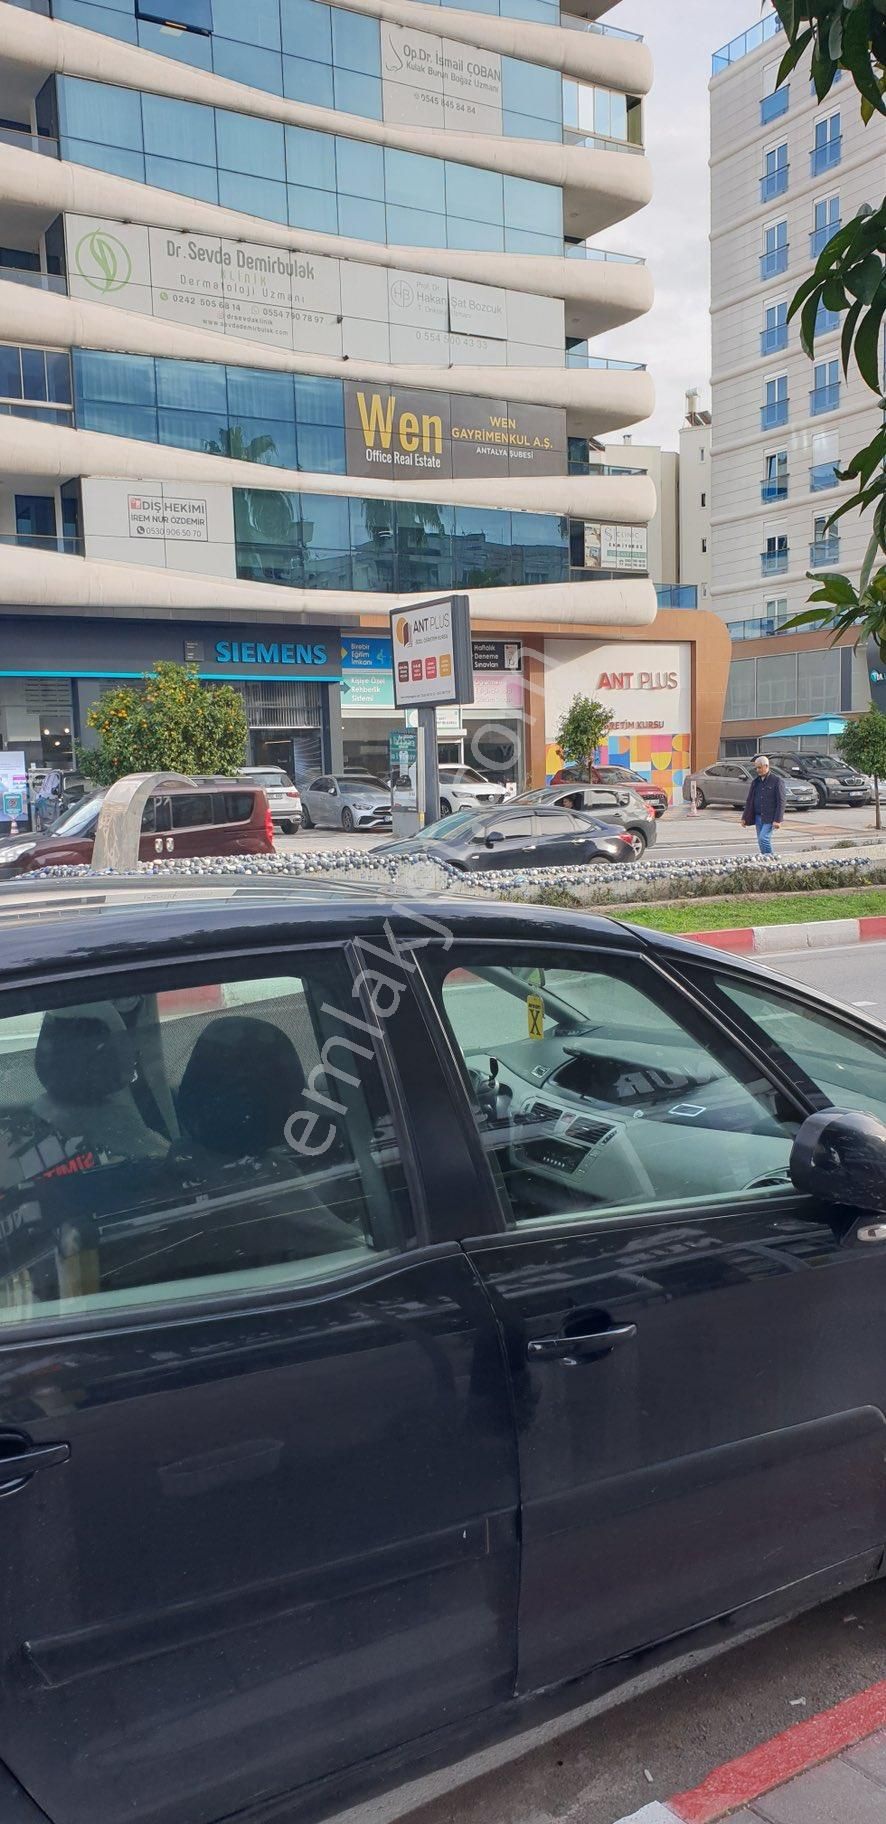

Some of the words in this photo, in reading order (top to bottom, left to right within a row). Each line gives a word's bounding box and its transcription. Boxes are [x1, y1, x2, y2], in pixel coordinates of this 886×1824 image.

[406, 61, 425, 73] Kulak
[428, 66, 448, 79] Burun
[451, 72, 472, 86] Boğaz
[436, 50, 464, 72] İsmail
[467, 62, 501, 82] ÇOBAN
[420, 93, 439, 105] 0545
[166, 239, 186, 259] Dr.
[188, 241, 231, 266] Sevda
[236, 249, 315, 280] Demirbulak
[180, 274, 255, 297] Dermatoloji
[263, 289, 305, 304] Uzmanı
[172, 294, 196, 305] 0242
[201, 299, 217, 308] 505
[232, 303, 241, 311] 14
[416, 291, 448, 306] Hakan
[469, 299, 503, 315] Bozcuk
[263, 307, 283, 318] 0554
[303, 314, 314, 322] 78
[315, 316, 324, 325] 97
[356, 391, 443, 455] Wen
[489, 415, 516, 429] WEN
[451, 426, 530, 447] GAYRİMENKUL
[533, 438, 553, 450] A.Ş.
[365, 448, 392, 464] Office
[394, 452, 413, 466] Real
[415, 454, 441, 469] Estate
[476, 446, 508, 458] ANTALYA
[509, 449, 534, 460] ŞUBESİ
[142, 500, 162, 513] DİŞ
[164, 501, 205, 514] HEKİMİ
[152, 515, 169, 524] NUR
[170, 515, 205, 526] ÖZDEMİR
[146, 526, 165, 535] 0530
[412, 617, 429, 634] ANT
[430, 613, 449, 631] PLUS
[215, 640, 328, 665] SIEMENS
[351, 650, 370, 659] Eğitim
[598, 672, 634, 689] ANT
[640, 671, 678, 690] PLUS
[351, 694, 373, 702] Sistemi
[636, 720, 665, 729] KURSU
